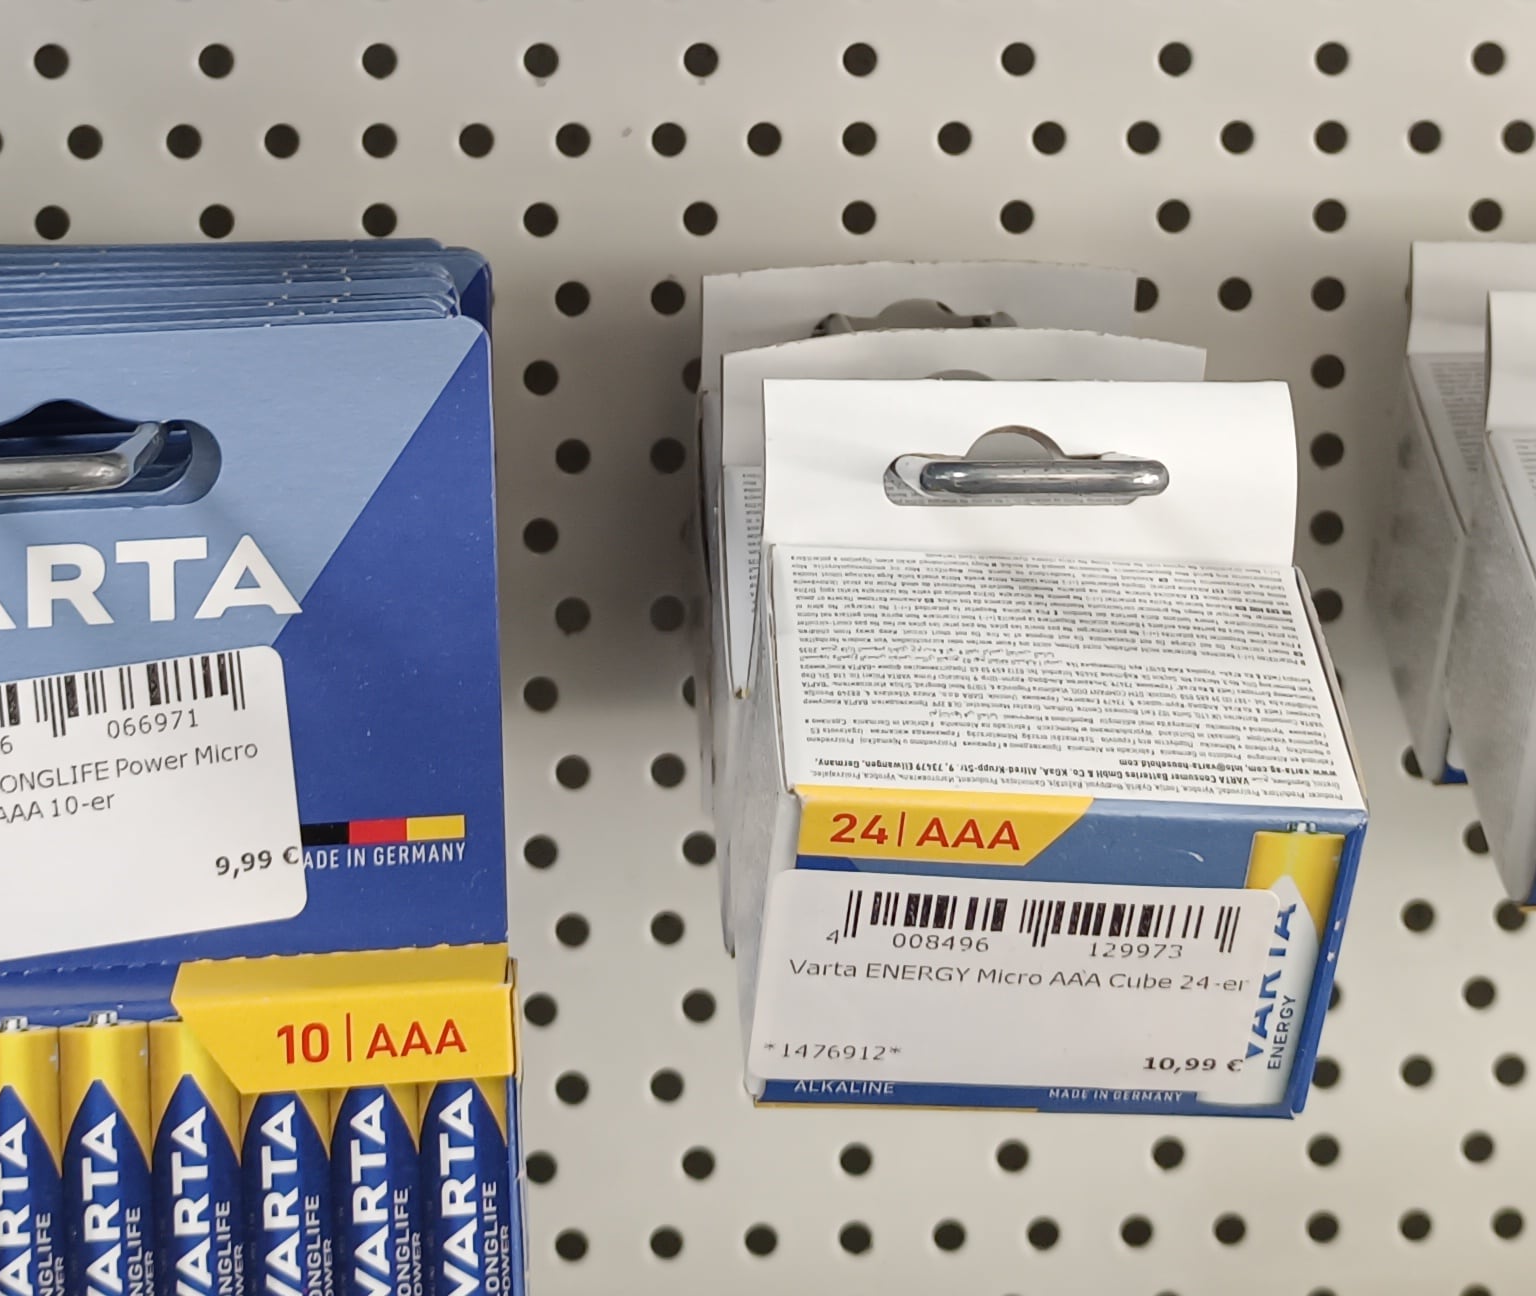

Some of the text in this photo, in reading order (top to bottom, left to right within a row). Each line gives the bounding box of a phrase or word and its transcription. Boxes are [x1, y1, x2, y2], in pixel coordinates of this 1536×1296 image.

[107, 708, 199, 739] 066971
[116, 750, 187, 779] Power
[194, 741, 258, 766] Micro
[51, 794, 114, 817] 10-er
[215, 845, 299, 878] 9,99 €
[346, 843, 466, 866] IN GERMANY
[892, 933, 1184, 960] 008496 129973
[789, 959, 1248, 992] Varta ENERGY Micro AAA Cube 24-er
[1267, 995, 1296, 1070] ENERGY
[1143, 1055, 1243, 1075] 10,99 €
[794, 1079, 894, 1095] ALKALINE
[1049, 1088, 1183, 1102] MADE GERMANY
